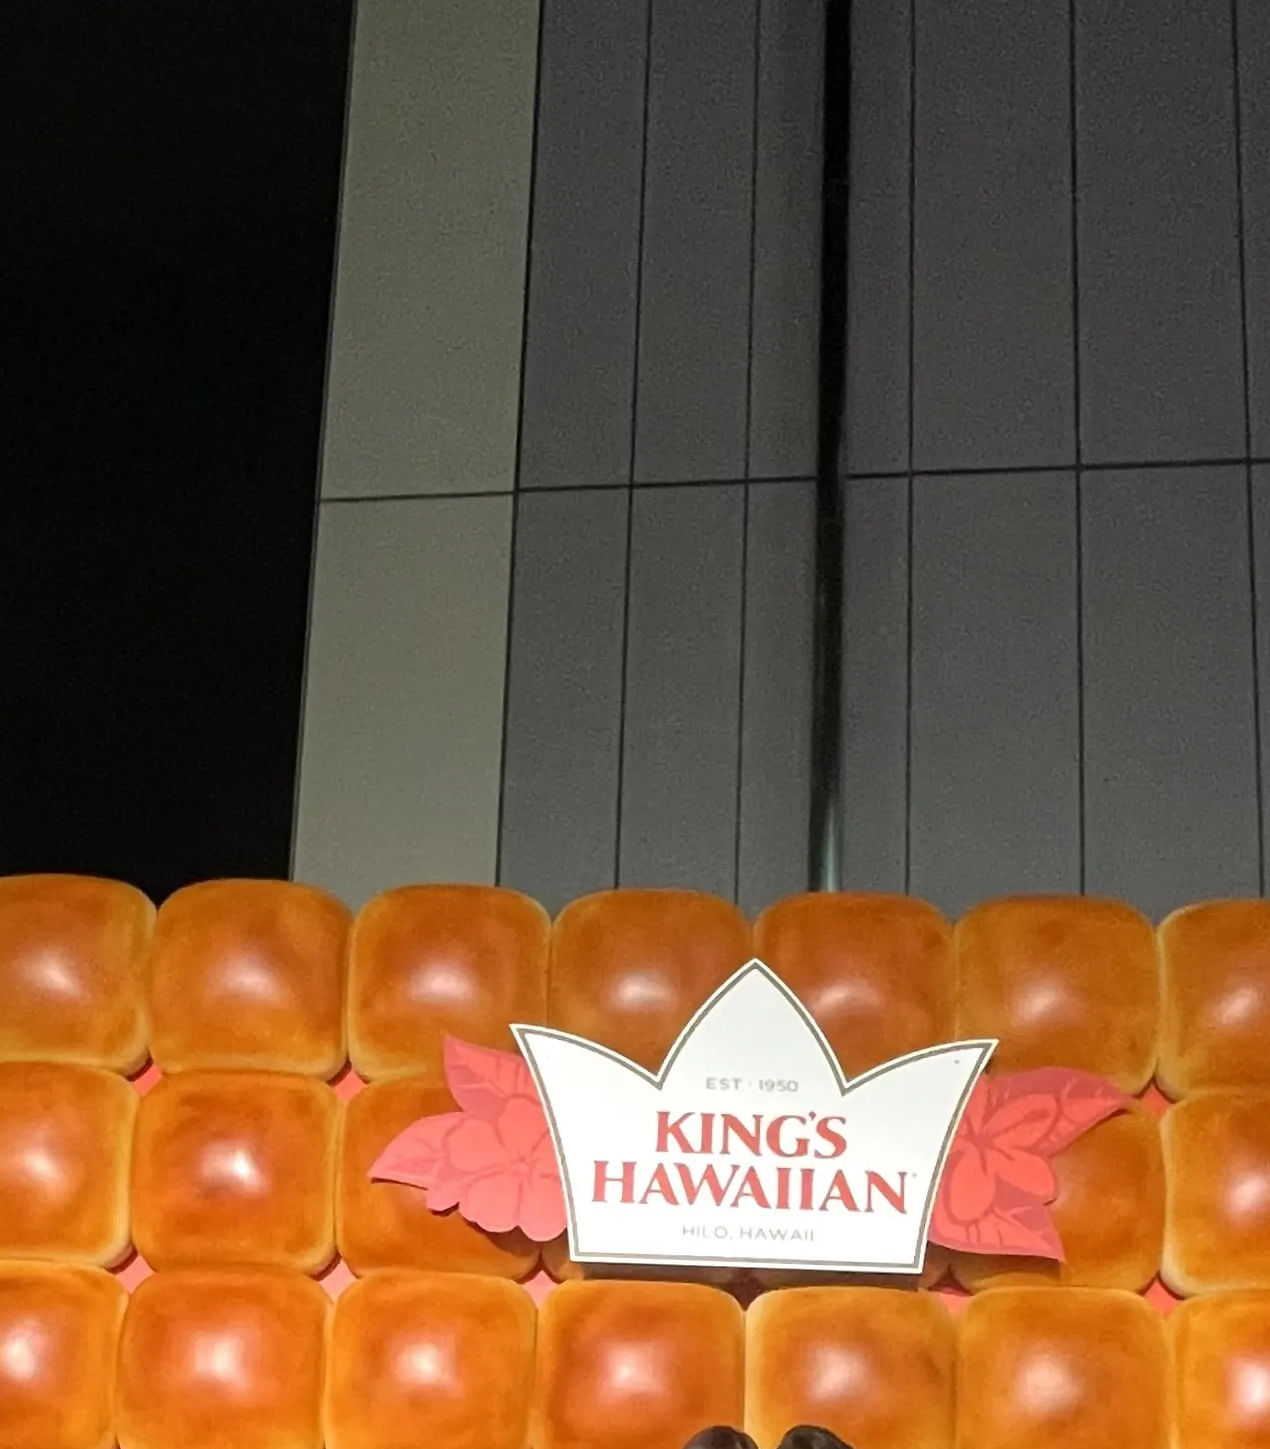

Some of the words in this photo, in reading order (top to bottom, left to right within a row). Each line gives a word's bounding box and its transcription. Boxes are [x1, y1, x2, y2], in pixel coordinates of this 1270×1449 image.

[706, 1078, 742, 1091] EST
[759, 1079, 799, 1093] 1950
[655, 1110, 847, 1159] KING'S
[592, 1160, 908, 1214] HAWAIIAN
[740, 1227, 814, 1242] HAWAII
